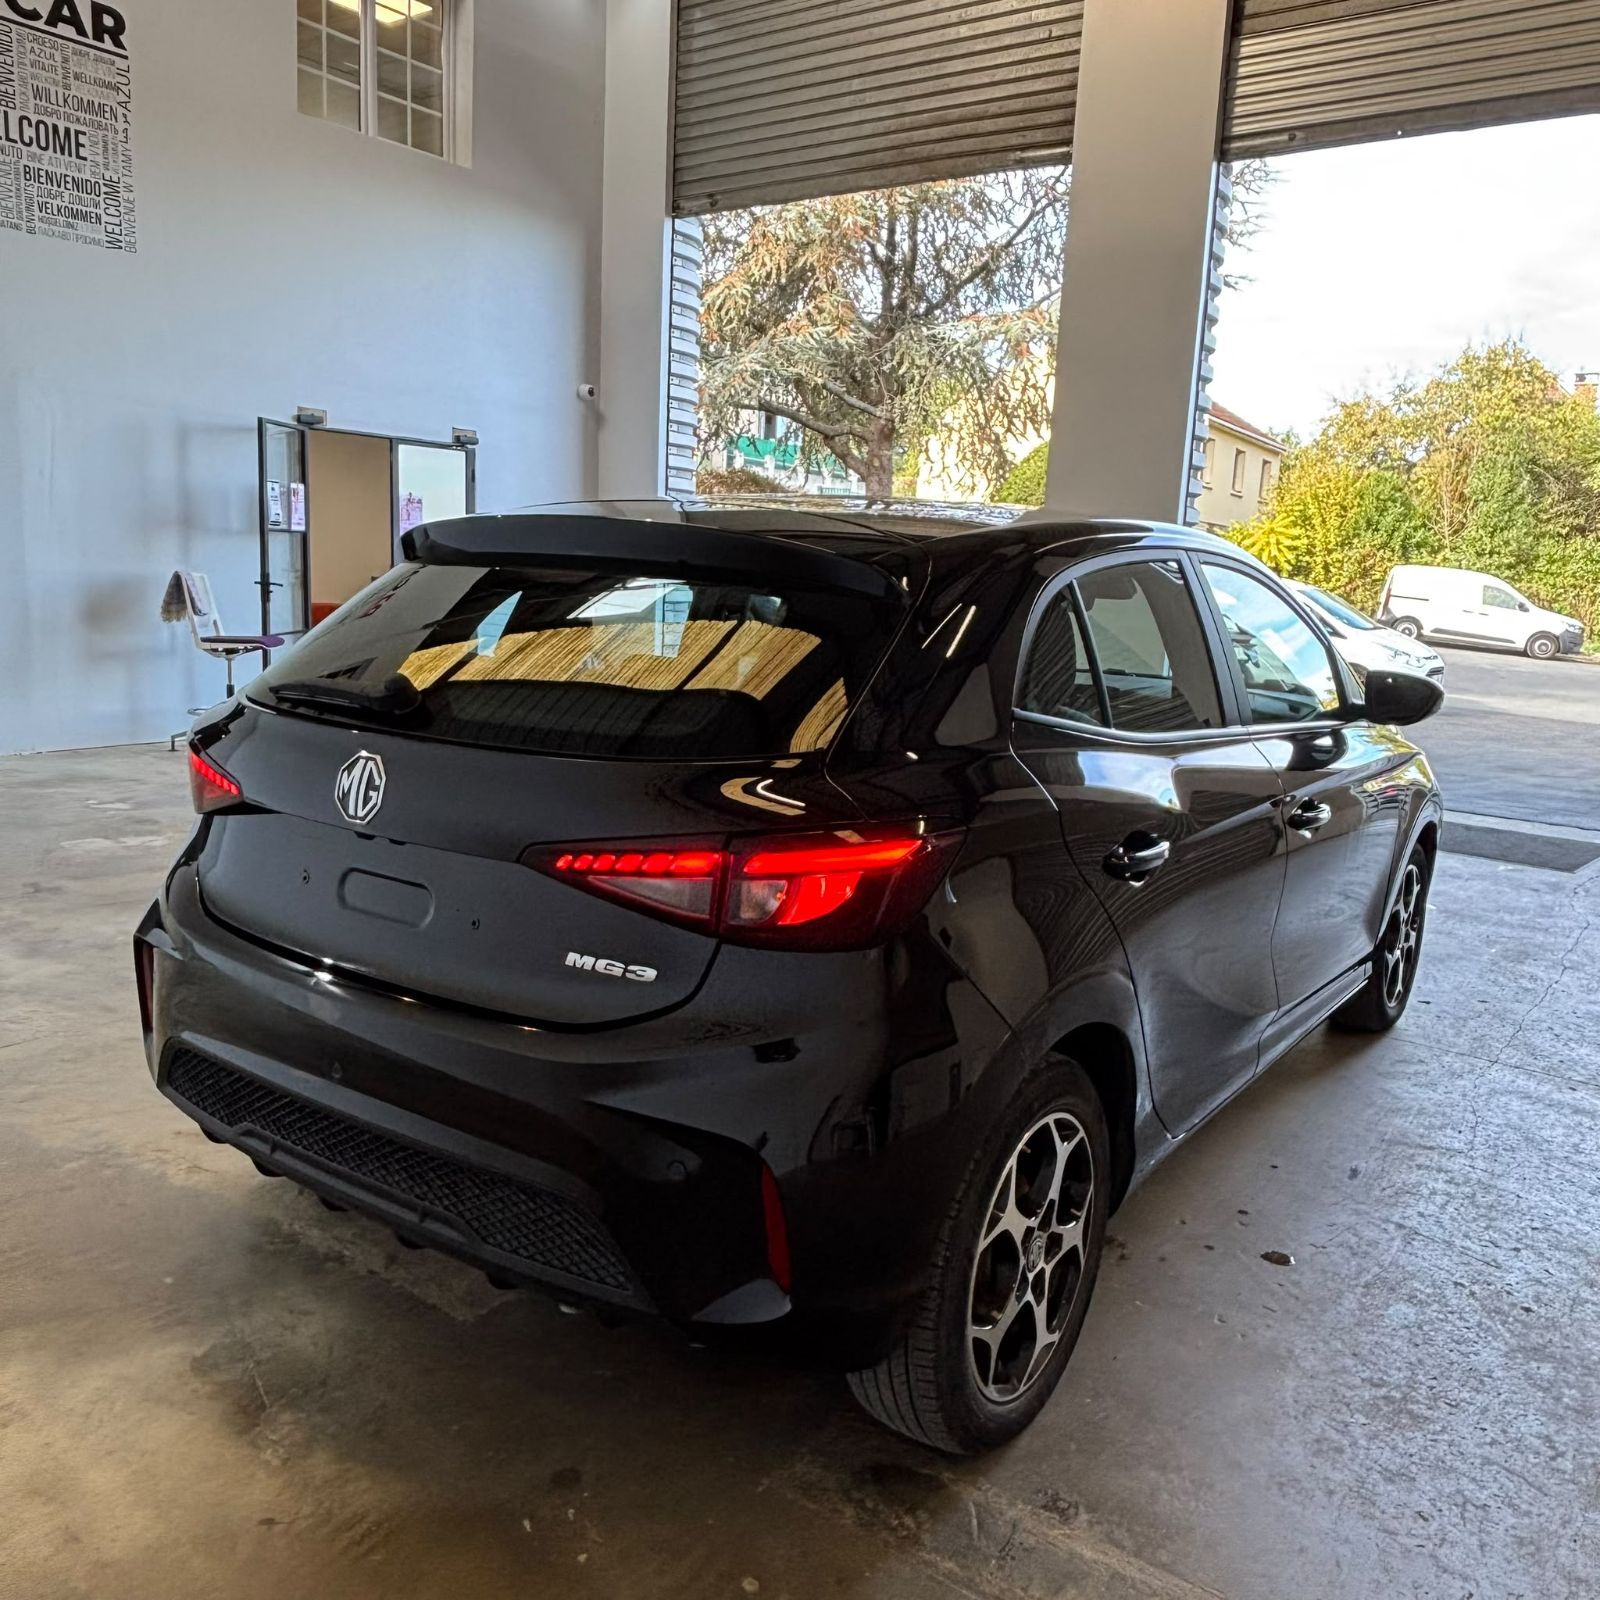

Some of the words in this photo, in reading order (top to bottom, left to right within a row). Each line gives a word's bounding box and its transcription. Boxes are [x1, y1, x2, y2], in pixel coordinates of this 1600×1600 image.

[27, 32, 59, 51] CROESO
[30, 46, 58, 63] AZUL
[31, 83, 118, 123] WILLKOMMEN
[116, 64, 131, 112] AZUL
[0, 110, 88, 161] LCOME
[23, 164, 101, 198] BIENVENIDO
[36, 186, 66, 203] ДОБРЕ
[37, 199, 102, 226] VELKOMMEN
[102, 172, 123, 250] WELCOME
[339, 759, 381, 817] MG
[565, 951, 658, 982] MG3
